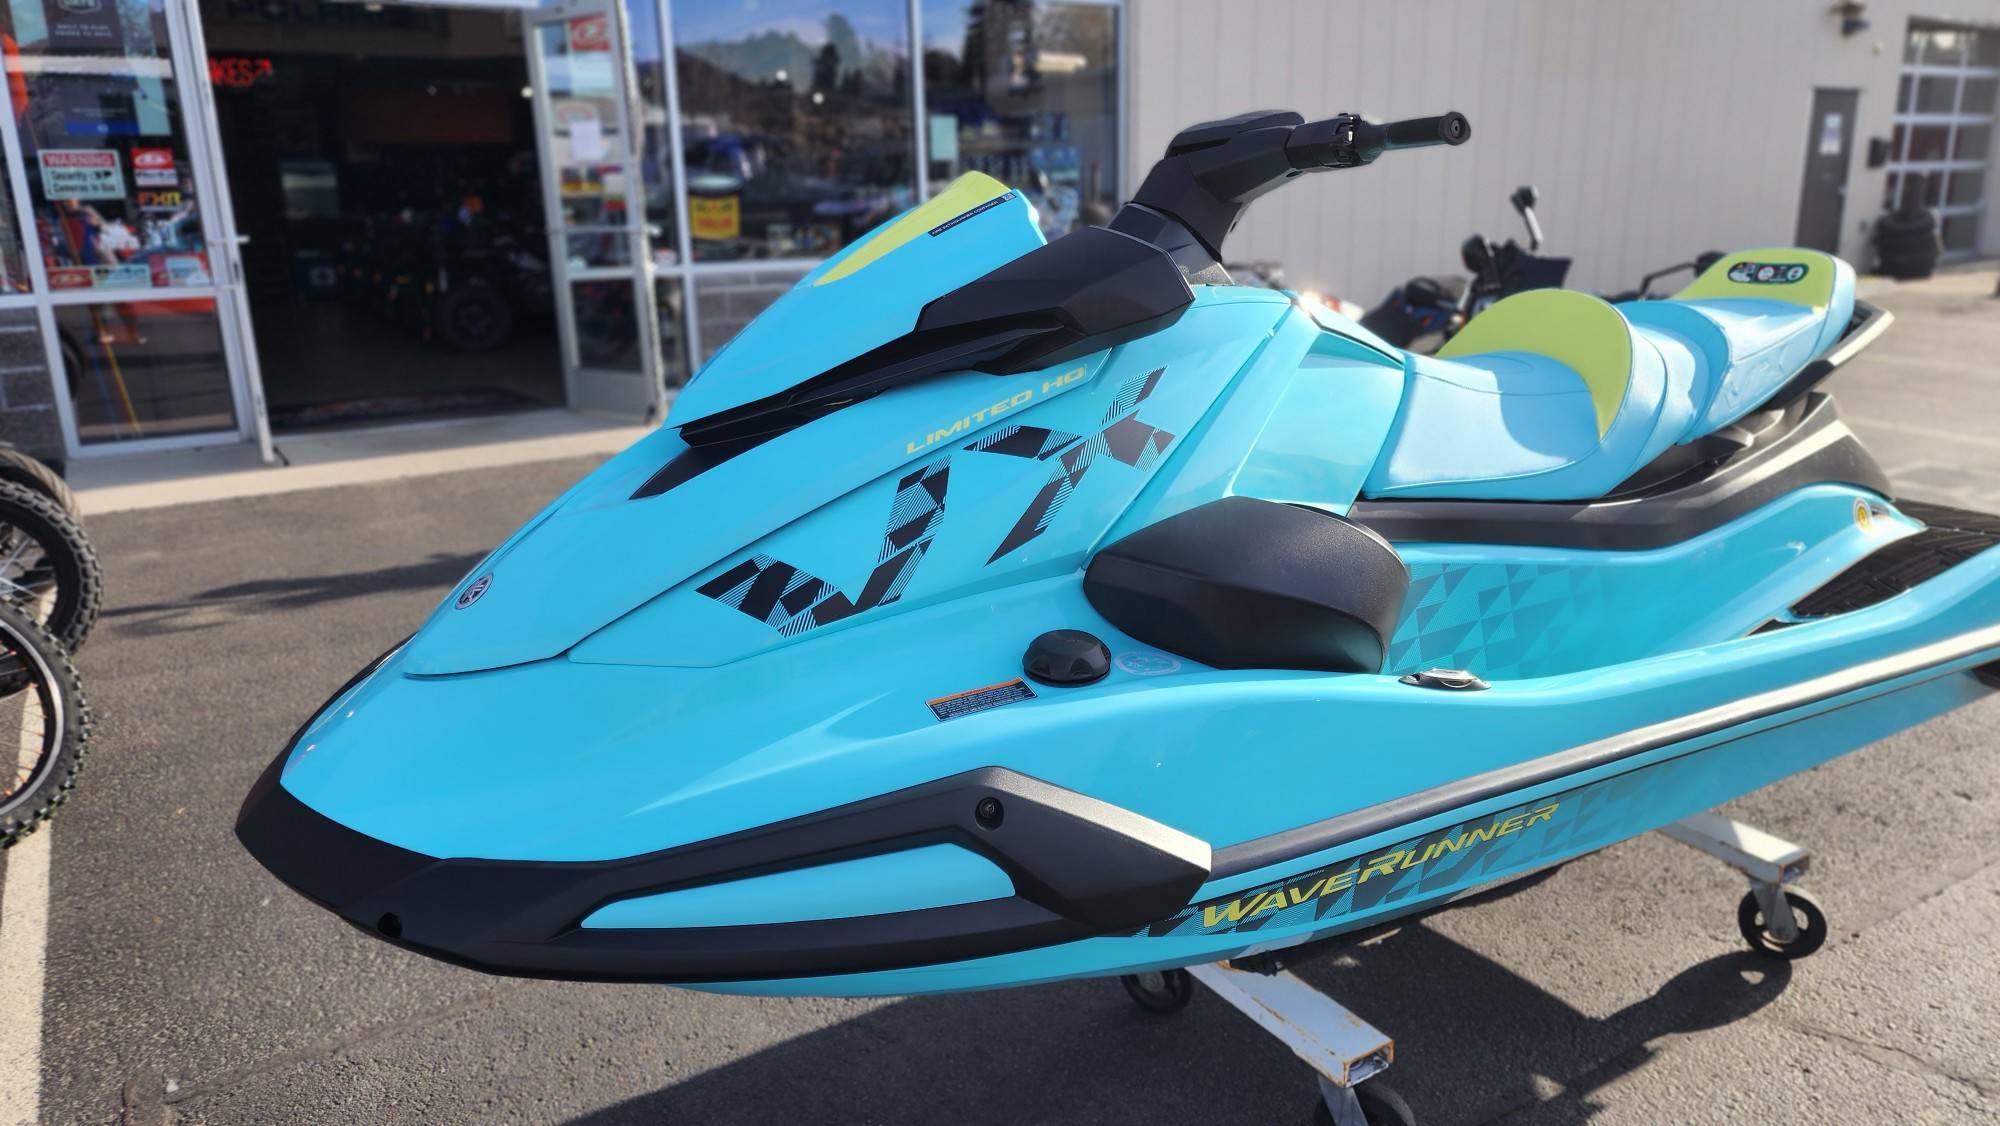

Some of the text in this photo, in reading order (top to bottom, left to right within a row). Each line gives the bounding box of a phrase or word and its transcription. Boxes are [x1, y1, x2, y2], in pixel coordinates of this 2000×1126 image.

[46, 153, 112, 167] WARNING
[50, 171, 88, 182] Security
[906, 389, 1034, 455] LIMITED
